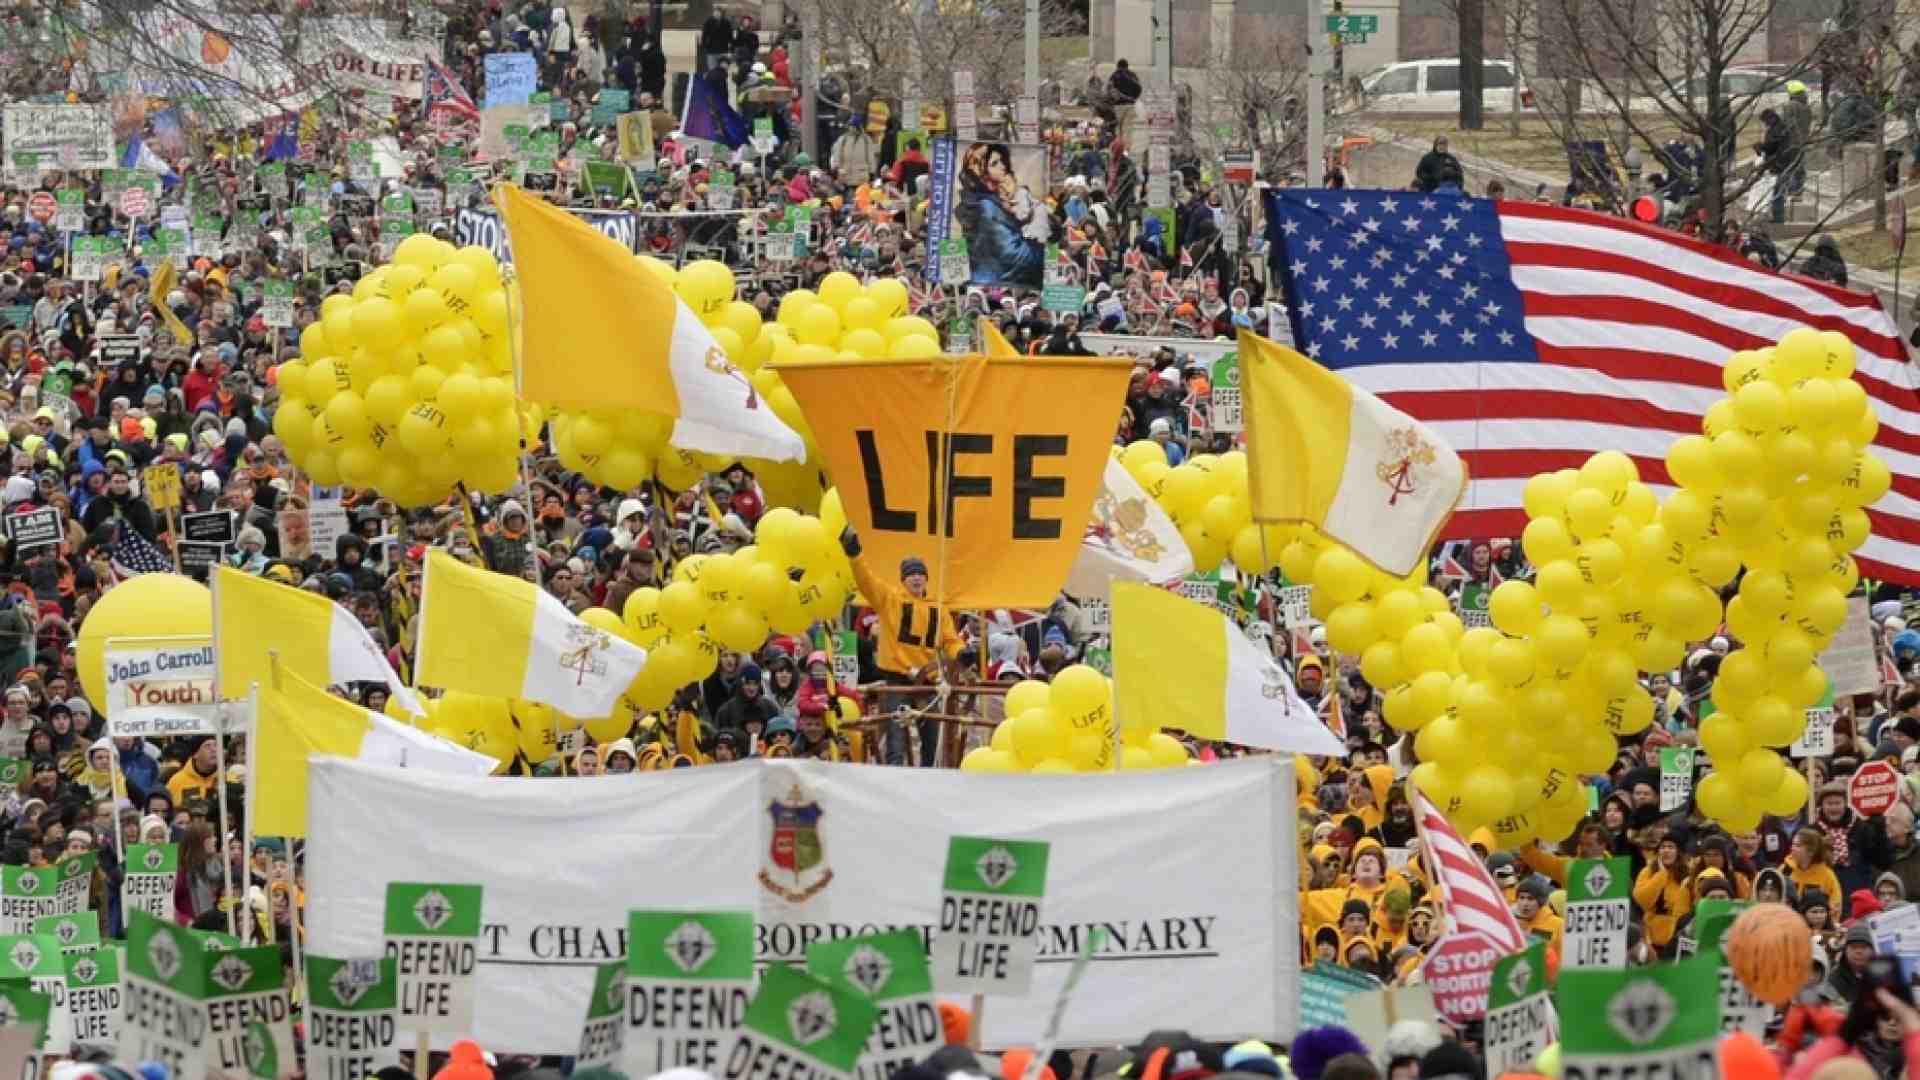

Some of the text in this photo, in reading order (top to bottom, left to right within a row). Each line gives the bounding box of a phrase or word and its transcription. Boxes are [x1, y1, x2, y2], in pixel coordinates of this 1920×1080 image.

[1337, 15, 1350, 31] 2
[457, 208, 502, 253] STO
[856, 430, 1067, 539] LIFE
[109, 646, 214, 683] John Carroll
[128, 681, 201, 706] Youth
[114, 721, 147, 733] FORT
[56, 875, 88, 899] EFEND
[127, 874, 174, 895] DEFEND
[2, 900, 56, 919] DEFEND
[941, 896, 1038, 937] DEFEND
[1565, 904, 1626, 933] DEFEND
[484, 925, 508, 955] T
[1577, 937, 1610, 966] LIFE
[957, 942, 1009, 979] LIFE
[1434, 950, 1496, 974] STOP
[69, 986, 119, 1013] EFEND
[208, 994, 285, 1033] EFEND
[402, 982, 452, 1016] LIFE
[75, 1014, 108, 1040] LIFE
[311, 1012, 395, 1050] DEFEND
